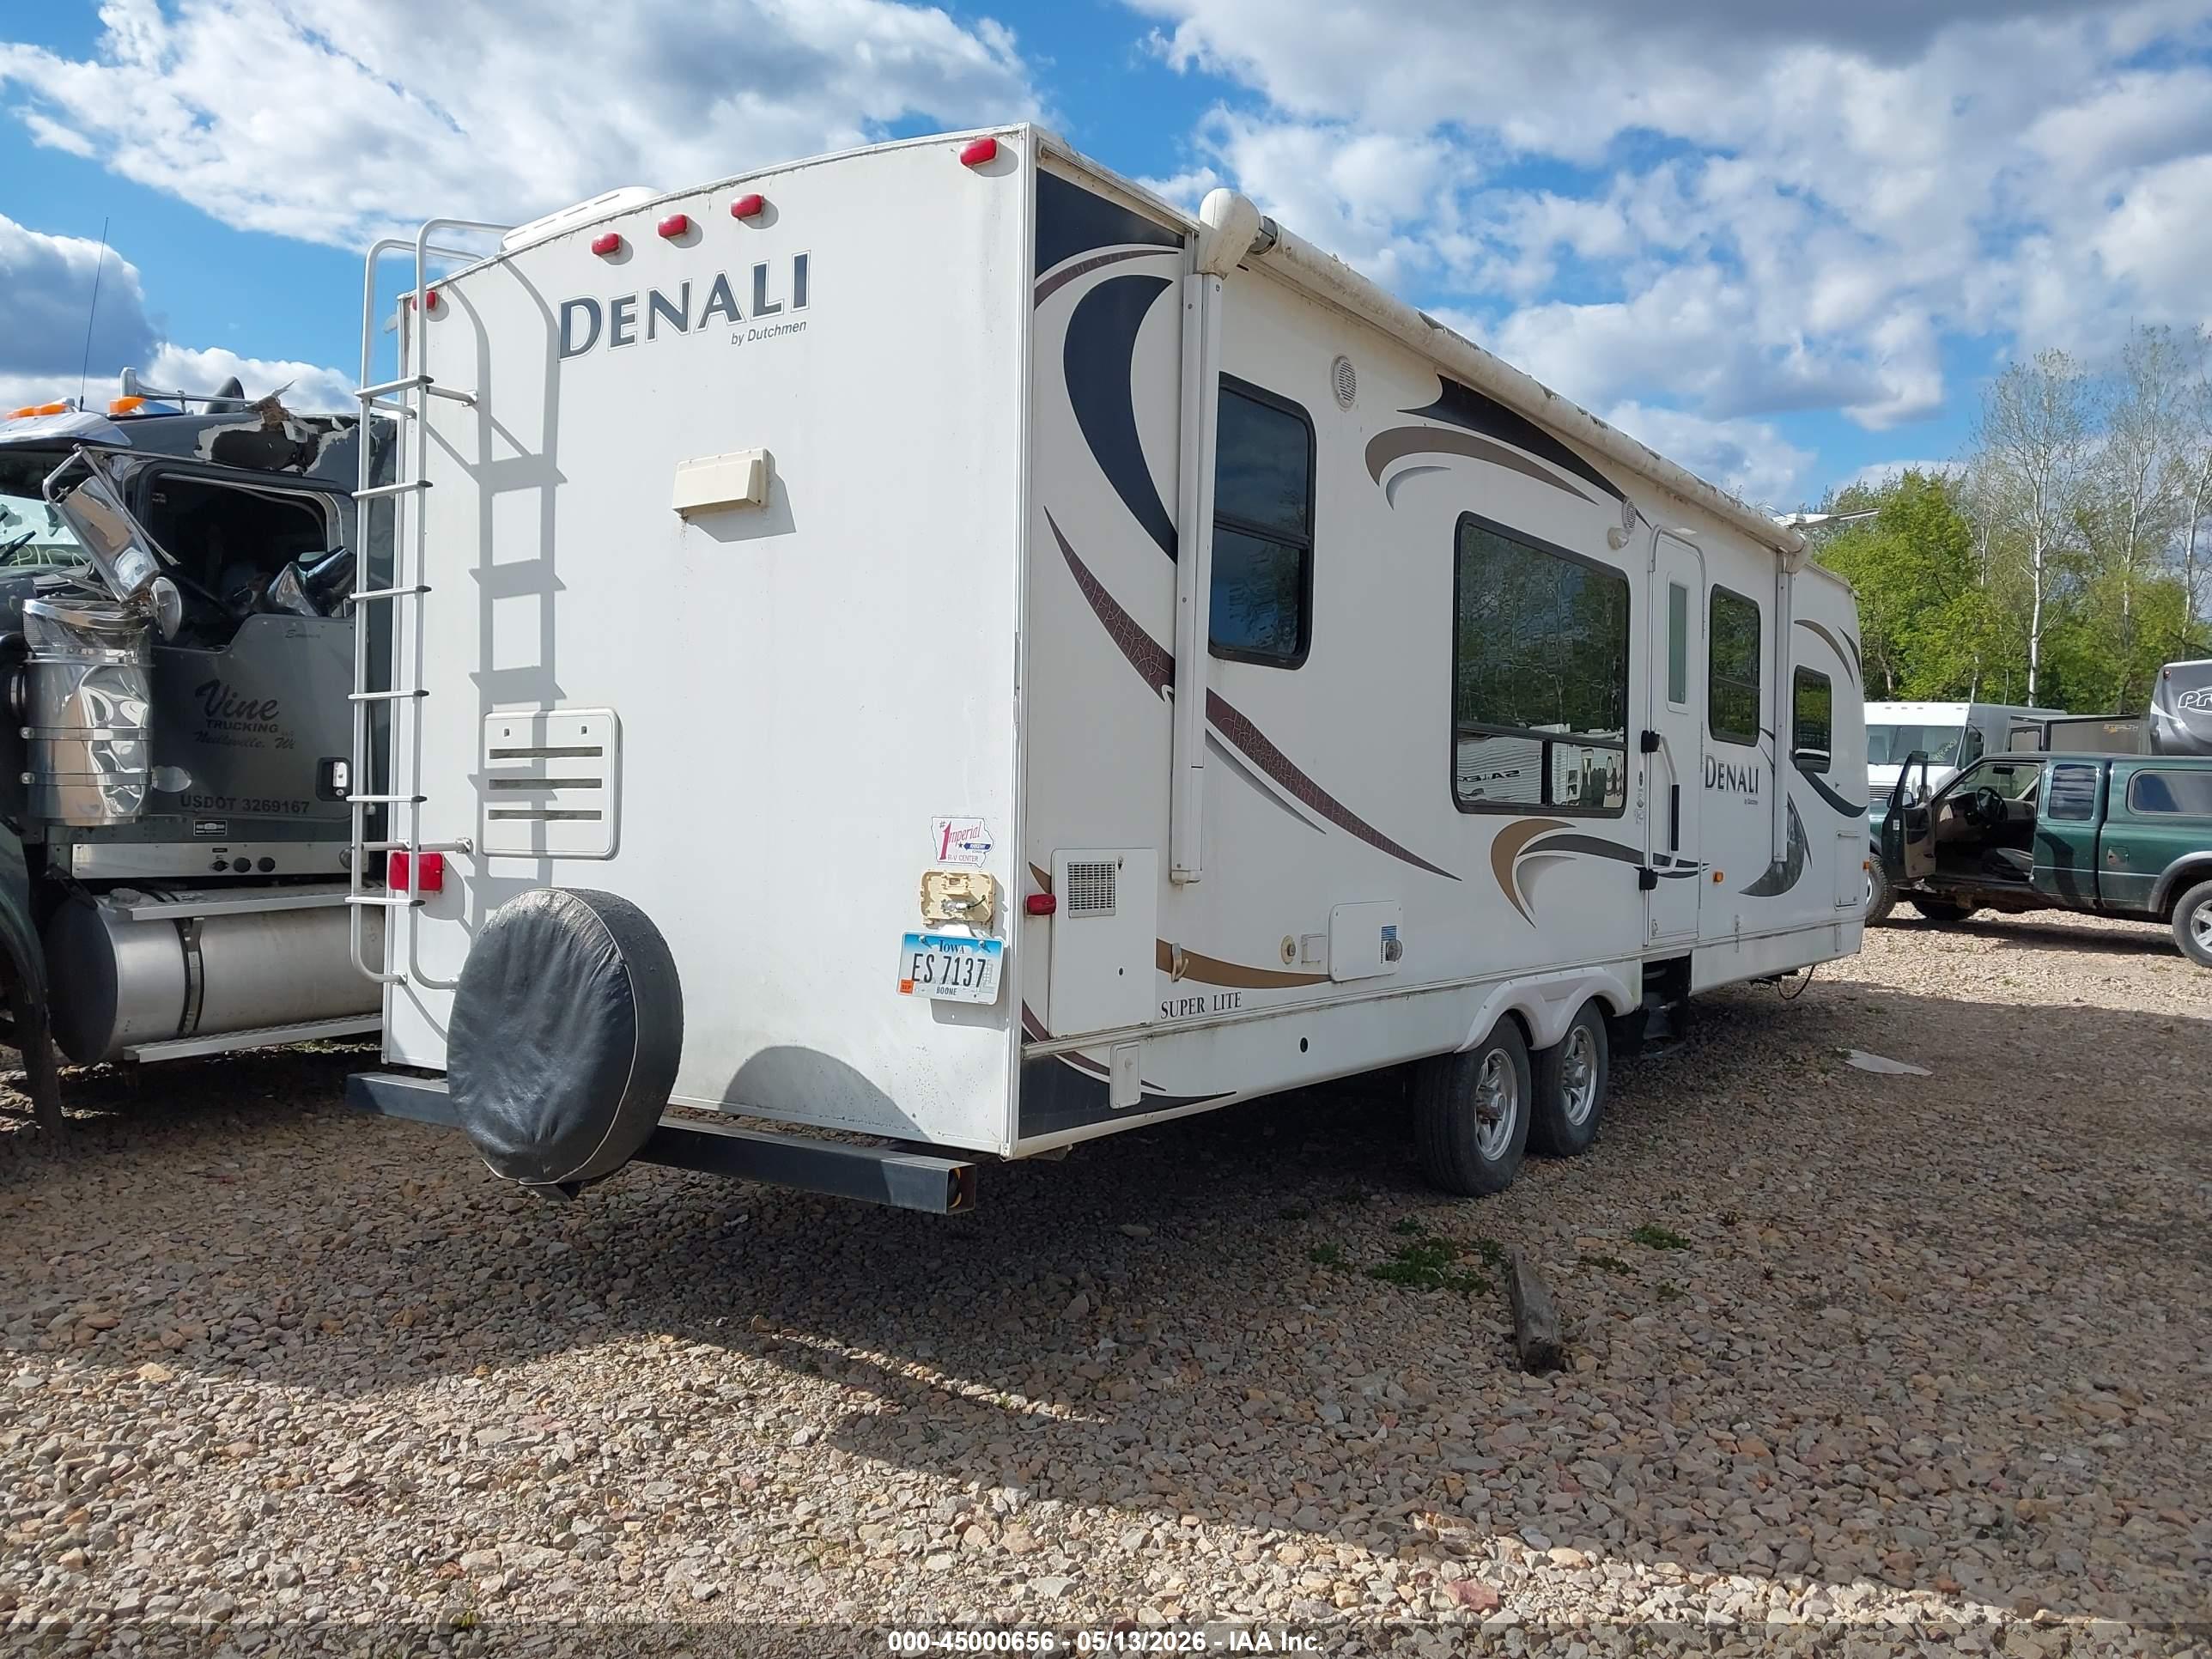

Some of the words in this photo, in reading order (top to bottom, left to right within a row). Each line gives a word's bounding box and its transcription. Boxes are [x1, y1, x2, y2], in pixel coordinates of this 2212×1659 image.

[558, 250, 811, 360] DENALI
[731, 332, 744, 346] by
[747, 321, 807, 342] Dutchmen
[194, 678, 279, 721] Vine
[2178, 690, 2212, 708] Pr
[205, 719, 278, 733] TRUCKING
[1705, 754, 1759, 795] DENALI
[180, 794, 237, 809] USDOT
[242, 799, 310, 813] 3269167
[912, 952, 935, 983] ES
[941, 955, 987, 988] 7137
[936, 986, 958, 996] BOONE
[1160, 997, 1206, 1019] SUPER
[1212, 991, 1242, 1012] LITE
